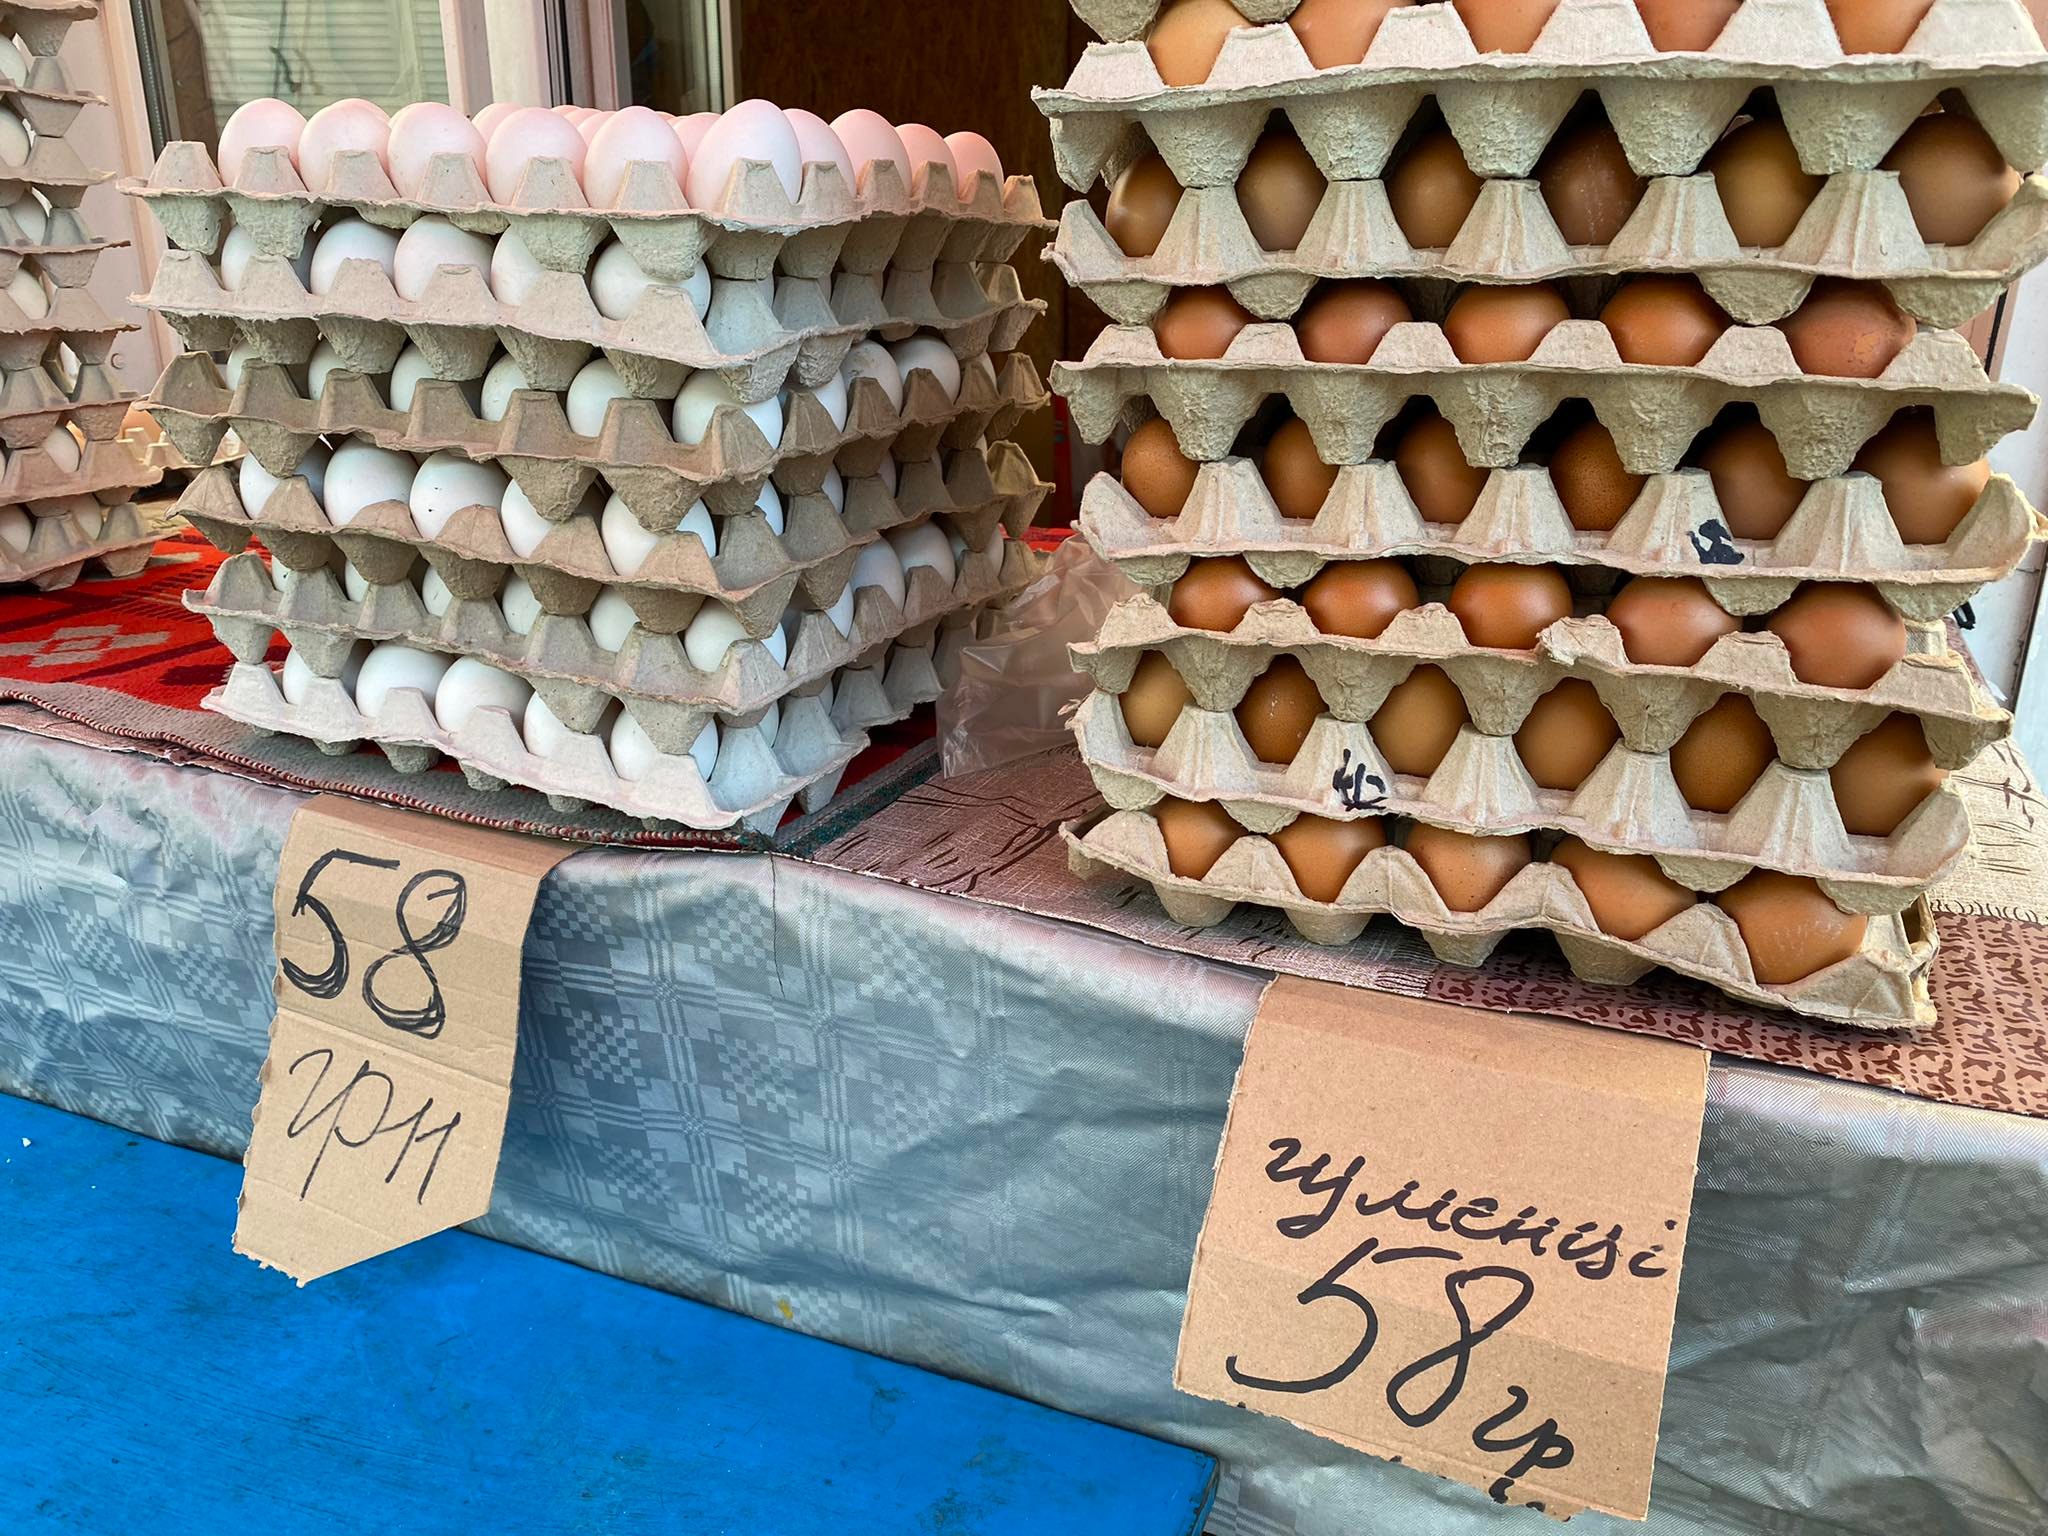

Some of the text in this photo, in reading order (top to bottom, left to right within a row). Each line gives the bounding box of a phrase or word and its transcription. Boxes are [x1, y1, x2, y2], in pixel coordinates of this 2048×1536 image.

[280, 848, 468, 1040] 58
[287, 1048, 462, 1205] грн
[1225, 1237, 1575, 1505] 58 гр
